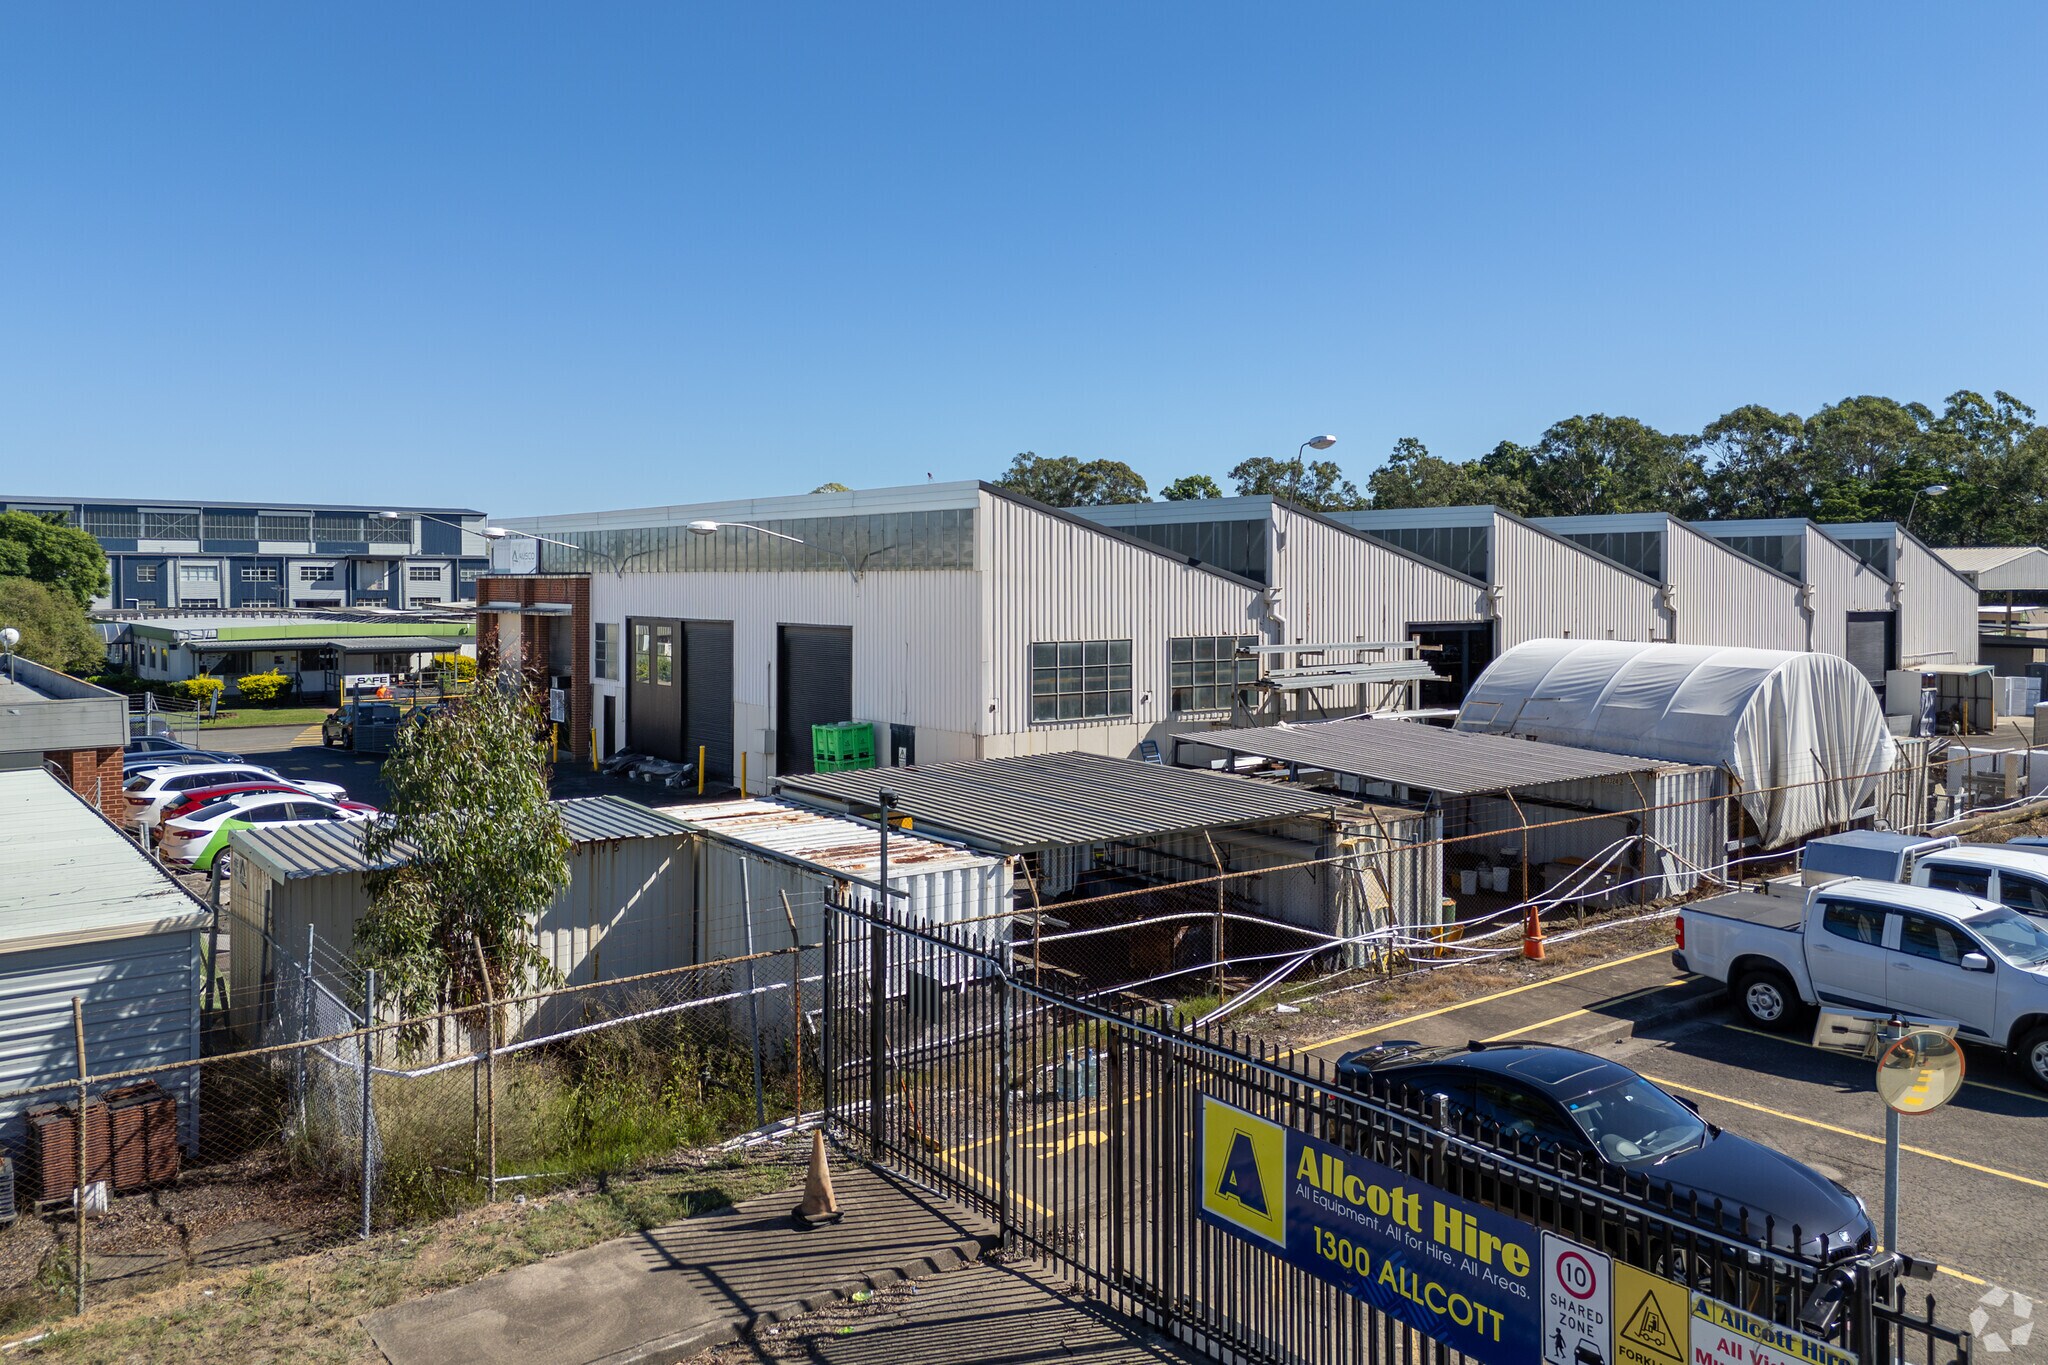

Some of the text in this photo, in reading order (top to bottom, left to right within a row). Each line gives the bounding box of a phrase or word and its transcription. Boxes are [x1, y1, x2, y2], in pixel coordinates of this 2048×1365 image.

[357, 676, 387, 684] SAFE
[1296, 1145, 1530, 1278] Allcott Hire
[1295, 1183, 1530, 1300] All Equipment. All for Hire. All Areas.
[1314, 1225, 1504, 1343] 1300 ALLCOTT
[1566, 1262, 1587, 1288] 10
[1550, 1292, 1604, 1325] SHARED
[1559, 1312, 1594, 1338] ZONE
[1720, 1308, 1795, 1352] Allcott
[1716, 1337, 1742, 1361] All
